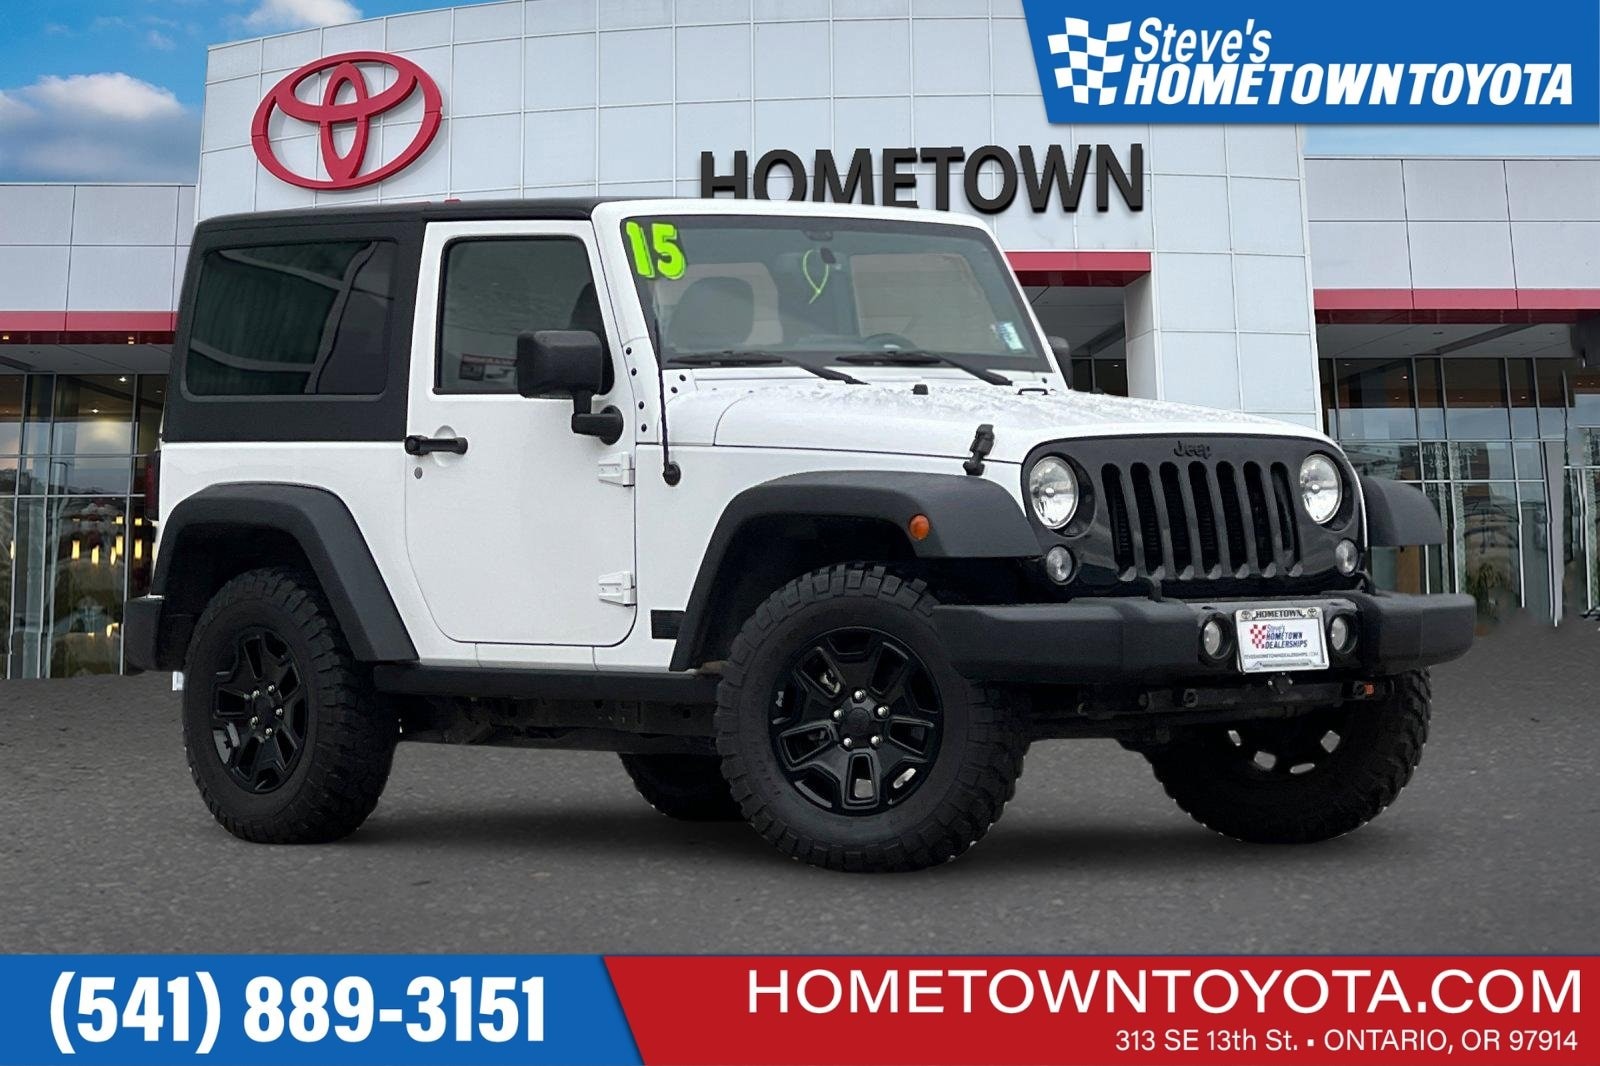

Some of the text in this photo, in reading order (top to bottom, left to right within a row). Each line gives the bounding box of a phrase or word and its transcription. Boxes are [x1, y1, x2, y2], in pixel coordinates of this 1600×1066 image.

[700, 143, 1145, 212] HOMETOWN
[625, 221, 686, 280] 15
[1173, 440, 1212, 460] Jeep
[1255, 609, 1303, 619] HOMETOWN
[1266, 631, 1303, 640] HOMETOWN
[1265, 639, 1308, 650] DEALERSHIPS
